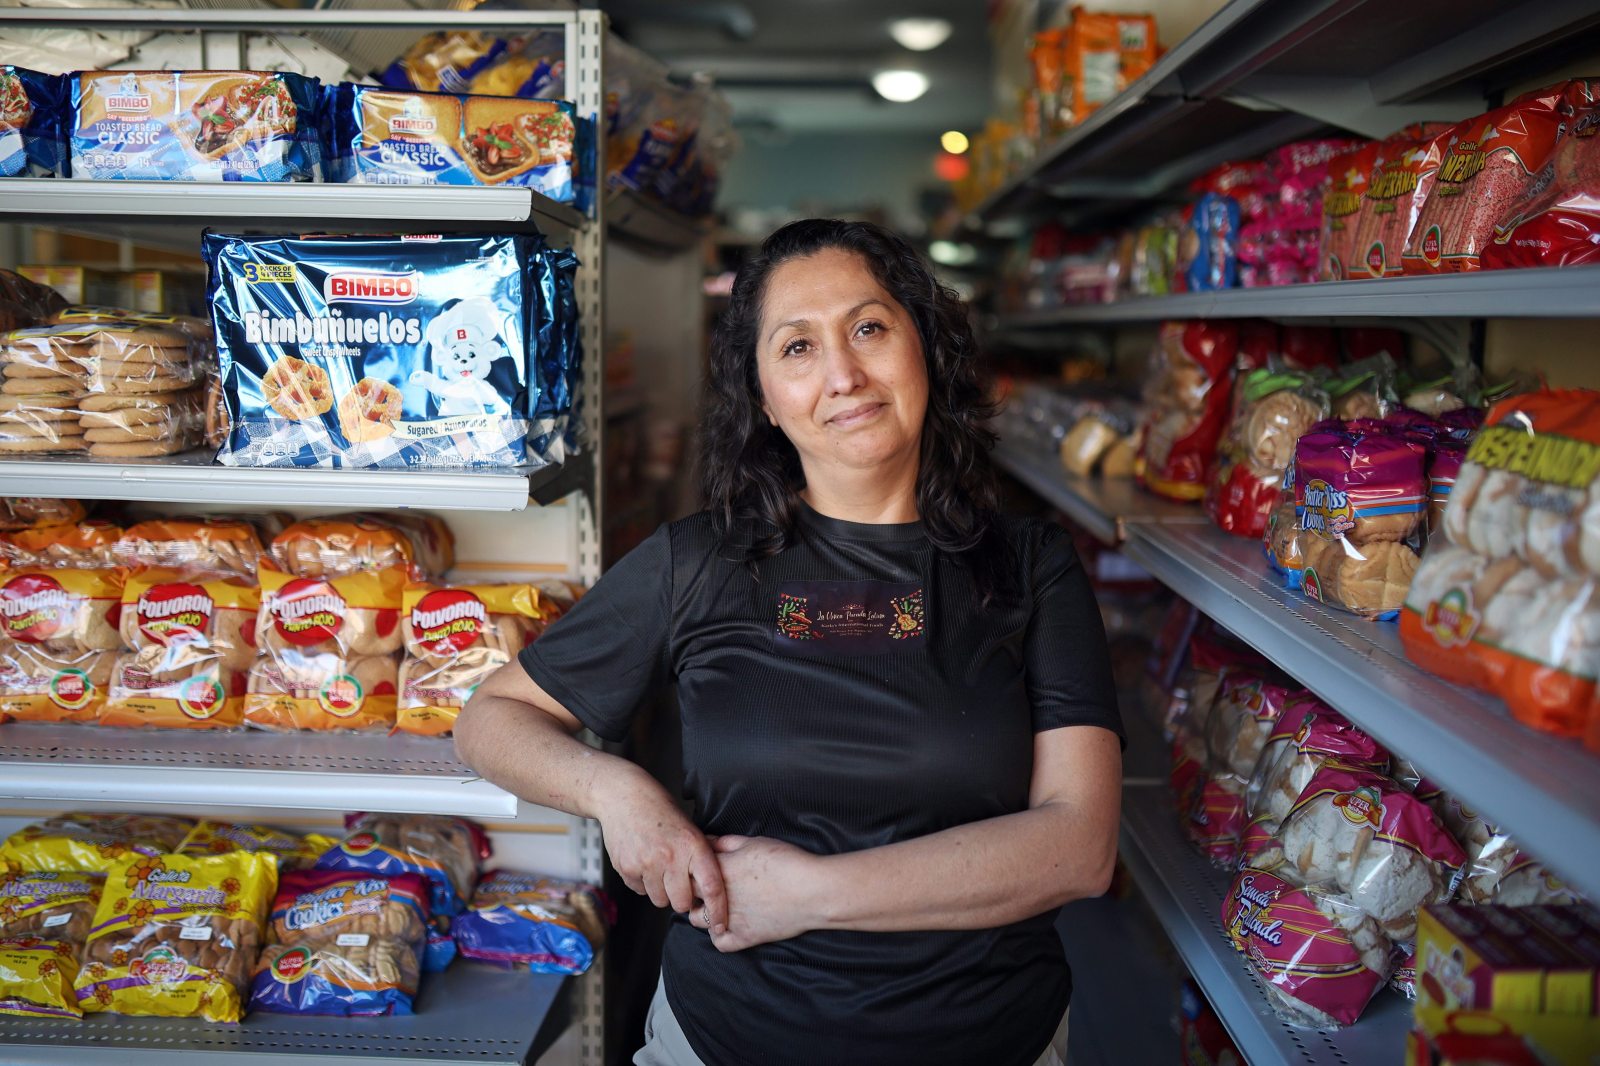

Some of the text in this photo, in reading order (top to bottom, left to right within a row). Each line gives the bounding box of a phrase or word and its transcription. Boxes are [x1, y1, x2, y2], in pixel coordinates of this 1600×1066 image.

[108, 97, 149, 108] BIMBO
[95, 123, 162, 132] TOASTED BREAD
[393, 120, 437, 131] BIMBO
[98, 131, 160, 145] CLASSIC
[379, 142, 416, 152] TOASTED
[380, 150, 446, 166] CLASSIC
[245, 264, 259, 282] 3
[331, 278, 412, 297] BIMBO
[245, 309, 421, 344] Bimbuñuelos
[457, 329, 467, 340] B
[304, 346, 322, 356] Sweet
[339, 346, 361, 357] Wheels
[407, 424, 438, 438] Sugared
[444, 418, 487, 432] Azucaros
[1304, 484, 1348, 513] Butter Kiss
[136, 594, 213, 619] POLVORON
[270, 595, 347, 620] POLVORON
[411, 601, 486, 630] POLVORON
[9, 608, 58, 631] PUNTO ROJO
[148, 612, 202, 632] PUNTO ROJO
[283, 613, 336, 633] PUNTO ROJO
[423, 619, 476, 642] PUNTO ROJO
[148, 868, 192, 882] Galleta
[0, 880, 91, 900] Margarita
[130, 879, 227, 908] Margarita
[353, 879, 389, 896] Kiss
[284, 900, 345, 930] Cookies
